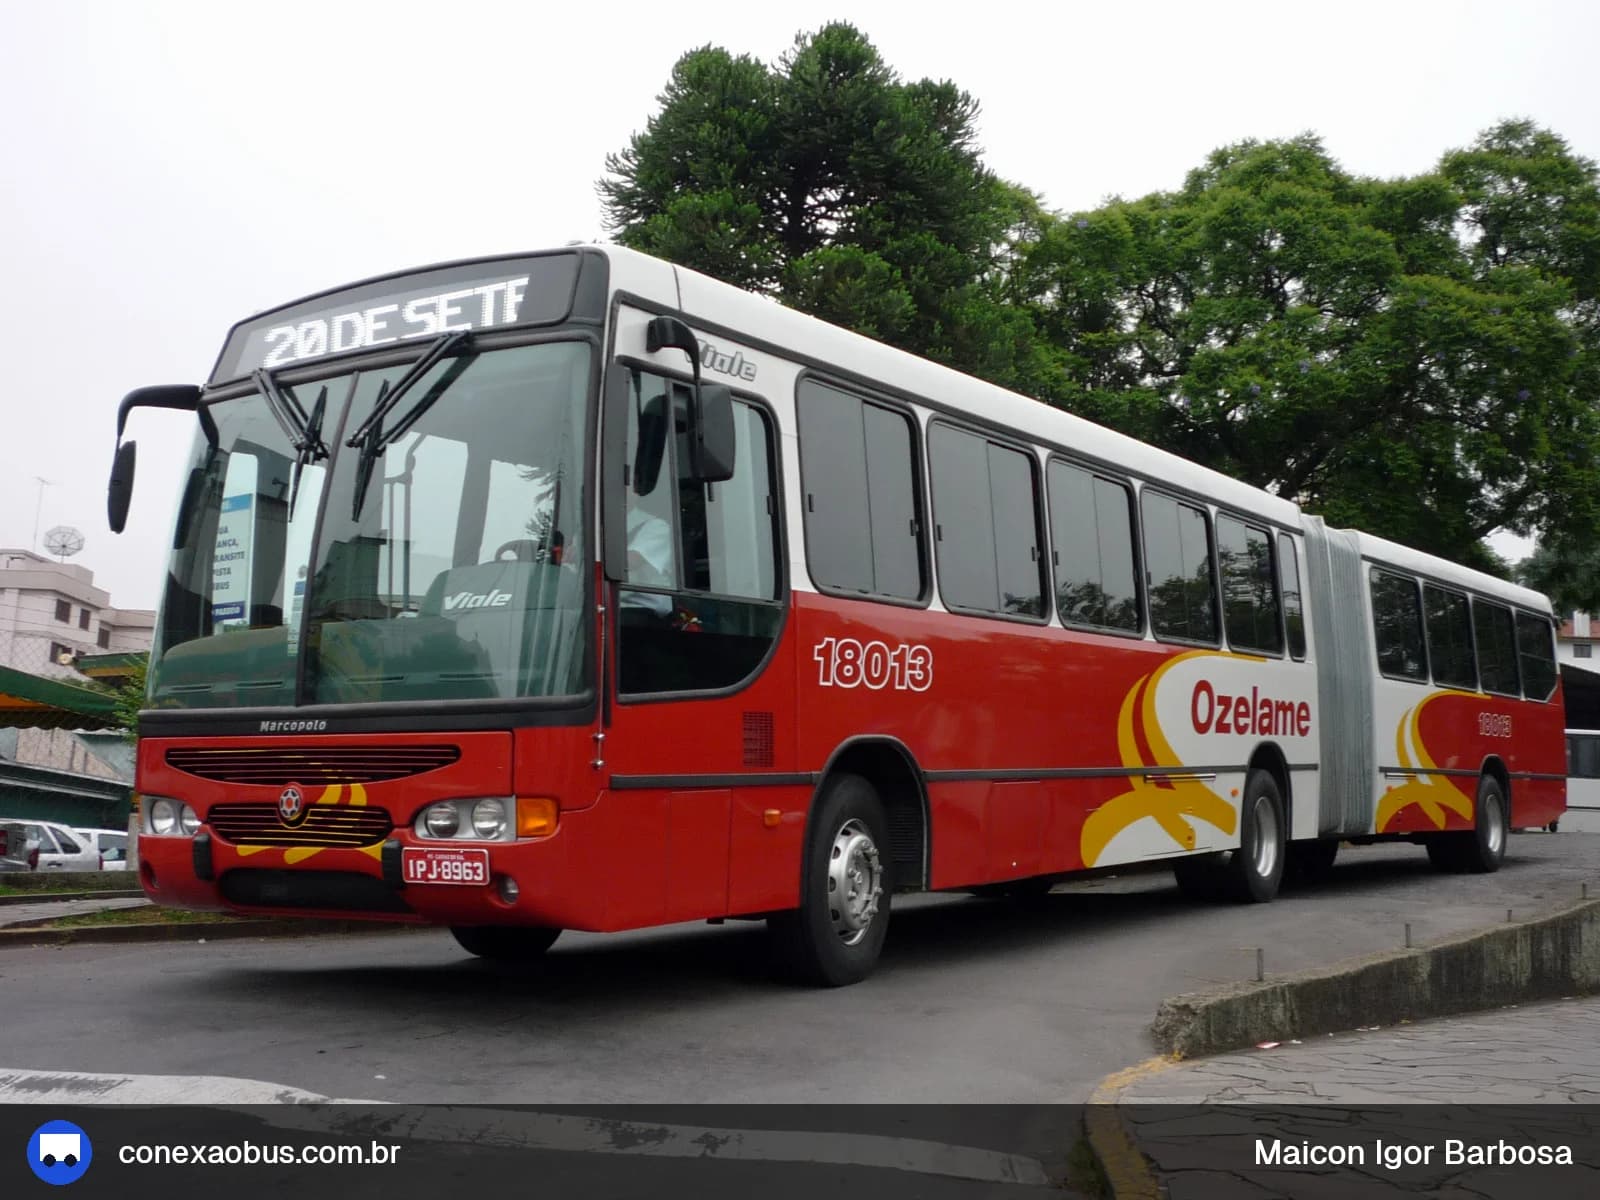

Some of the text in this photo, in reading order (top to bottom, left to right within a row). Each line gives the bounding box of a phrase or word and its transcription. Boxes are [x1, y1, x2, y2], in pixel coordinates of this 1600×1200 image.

[263, 317, 329, 368] 20
[330, 304, 399, 354] DE
[443, 589, 513, 610] Viale
[813, 637, 933, 692] 18013
[259, 719, 327, 732] Marcopolo
[1191, 679, 1311, 737] Ozelame
